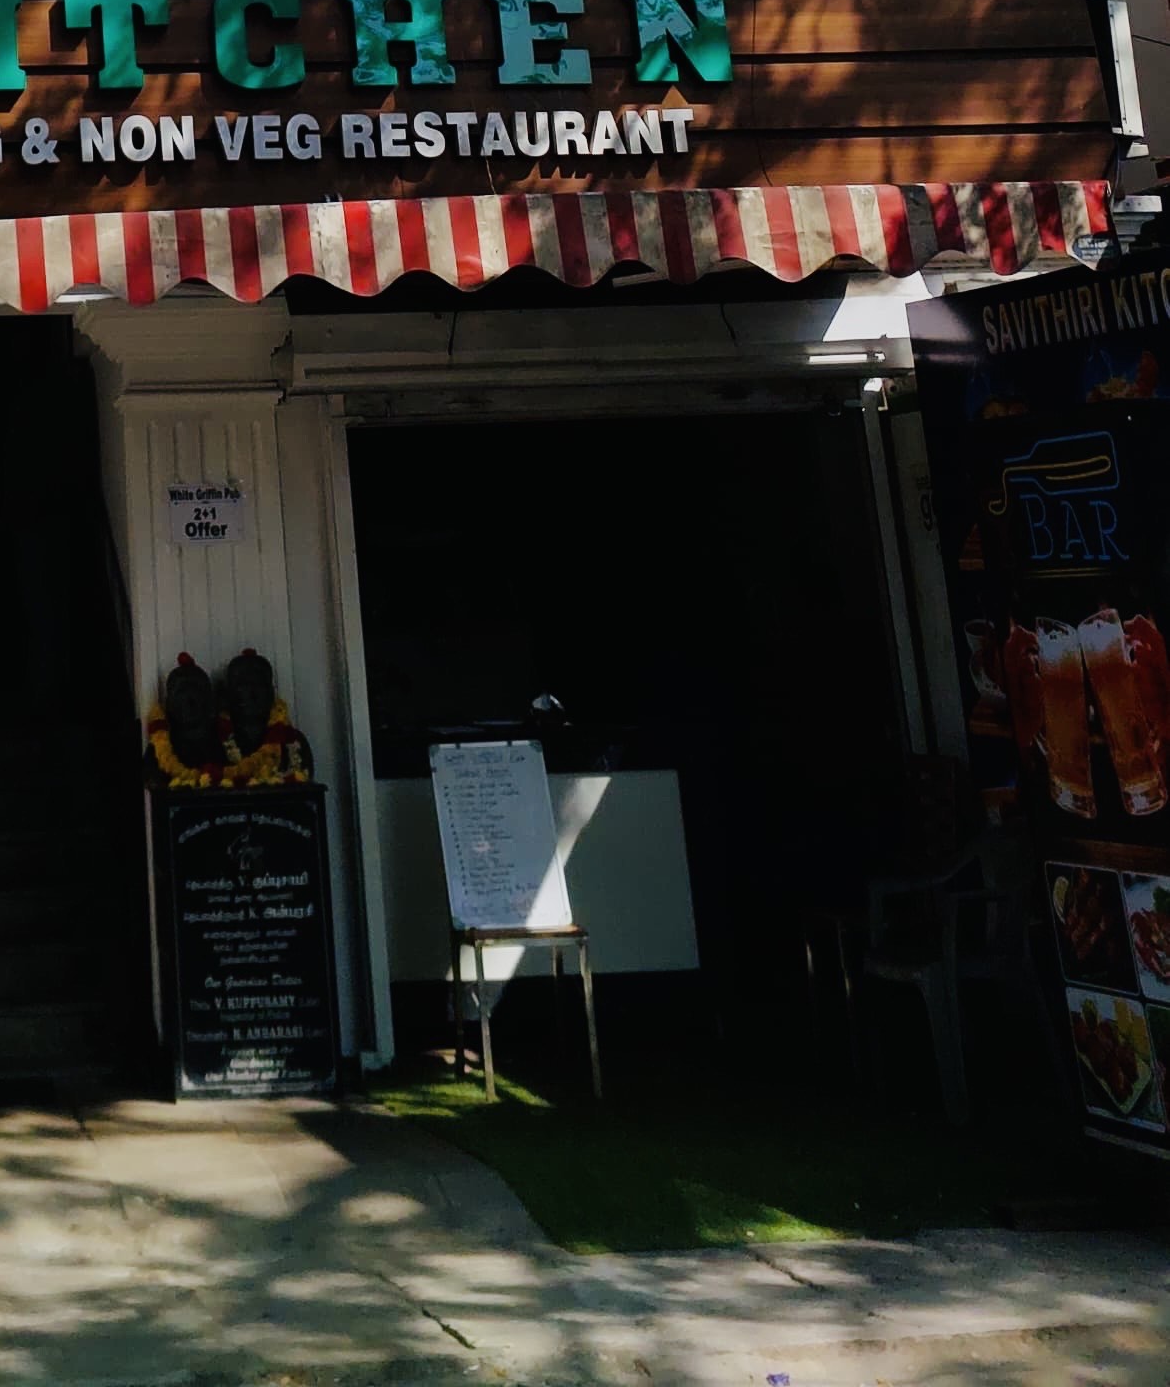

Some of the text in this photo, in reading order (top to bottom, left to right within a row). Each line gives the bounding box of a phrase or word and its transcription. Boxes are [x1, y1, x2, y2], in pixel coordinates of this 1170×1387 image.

[20, 113, 57, 166] &
[80, 112, 198, 164] NON
[213, 111, 323, 162] VEG
[342, 108, 693, 160] RESTAURANT
[983, 283, 1108, 354] SAVITHIRI
[185, 522, 227, 537] Offer
[194, 507, 216, 520] 2+1
[1020, 494, 1129, 560] BAR
